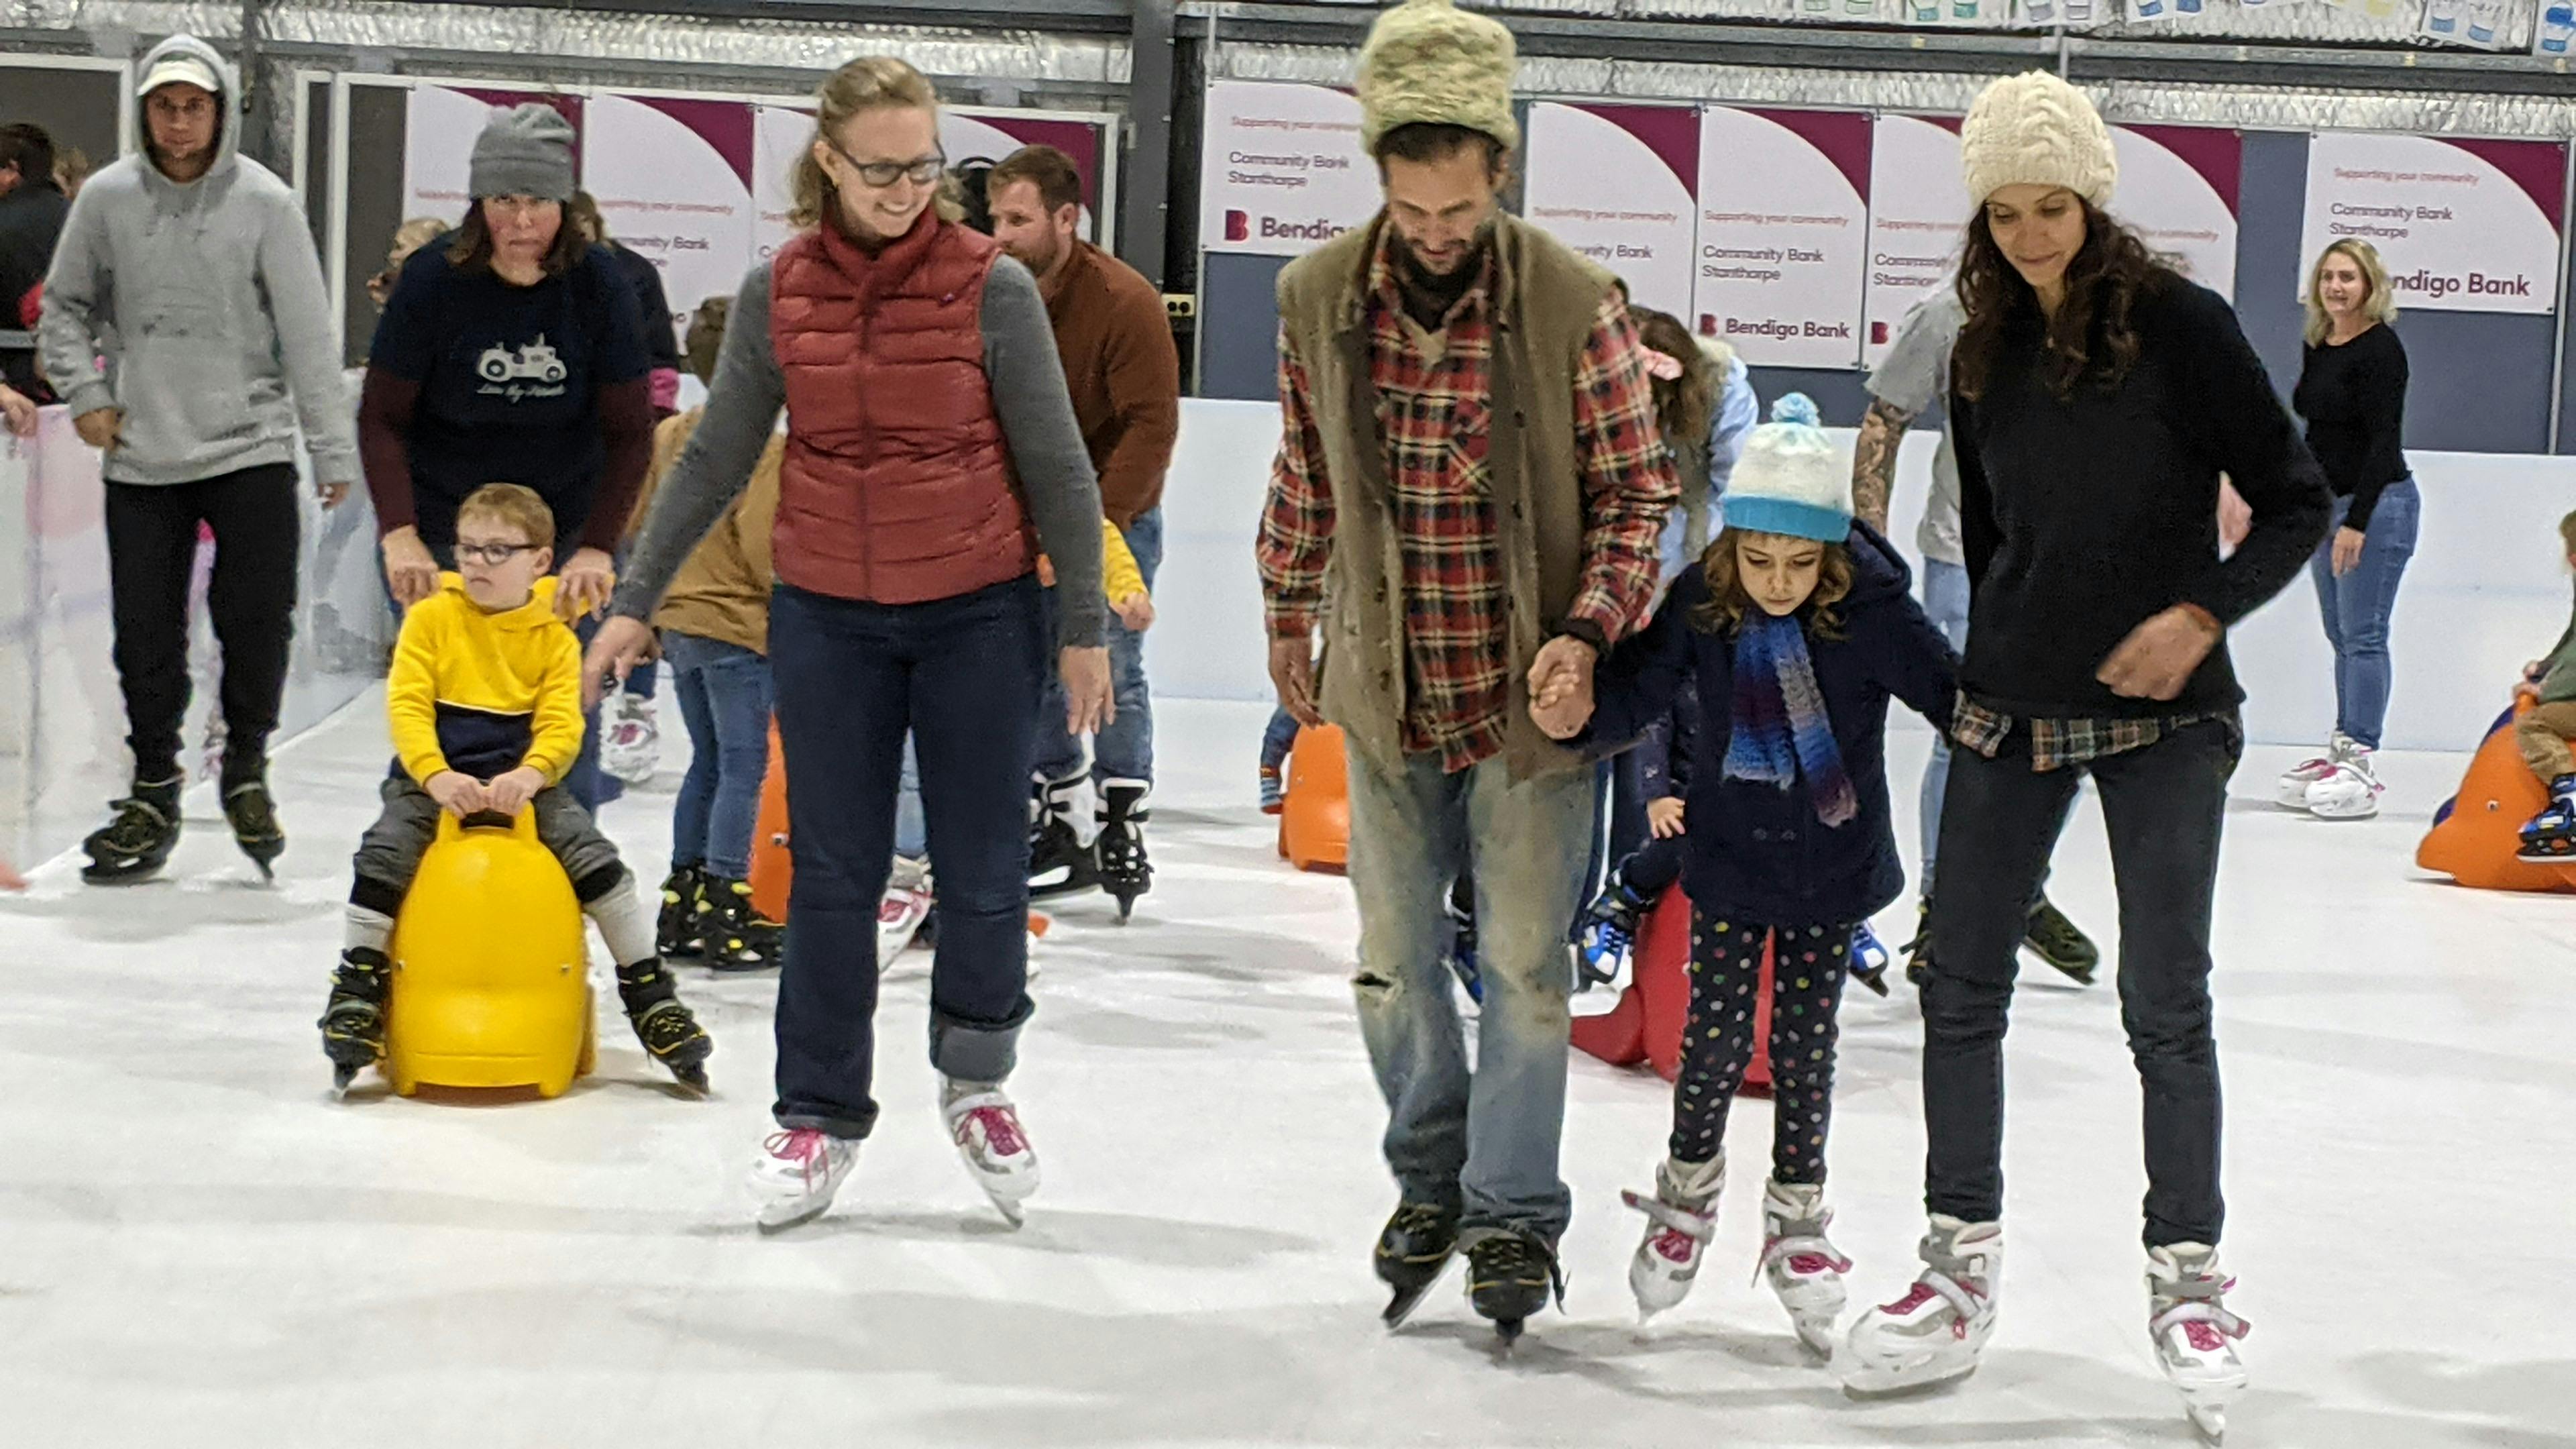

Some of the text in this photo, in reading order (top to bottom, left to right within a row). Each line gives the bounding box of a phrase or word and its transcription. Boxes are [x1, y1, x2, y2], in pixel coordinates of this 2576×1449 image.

[1232, 116, 1289, 131] Supporting
[1230, 152, 1349, 170] Community Bank
[1229, 170, 1307, 189] Stanthorpe
[2334, 168, 2480, 188] Supporting your community
[1705, 210, 1849, 227] Supporting your community
[2330, 203, 2453, 222] Community Bank
[1261, 216, 1346, 240] Bendi
[2330, 222, 2409, 240] Stanthorpe
[673, 235, 709, 251] Bank
[1617, 244, 1653, 259] Bank
[1703, 245, 1824, 264] Community Bank
[1702, 264, 1781, 283] Stanthorpe
[2391, 268, 2531, 299] ndigo Bank
[1725, 318, 1799, 341] Bendigo
[1804, 321, 1851, 339] Bank
